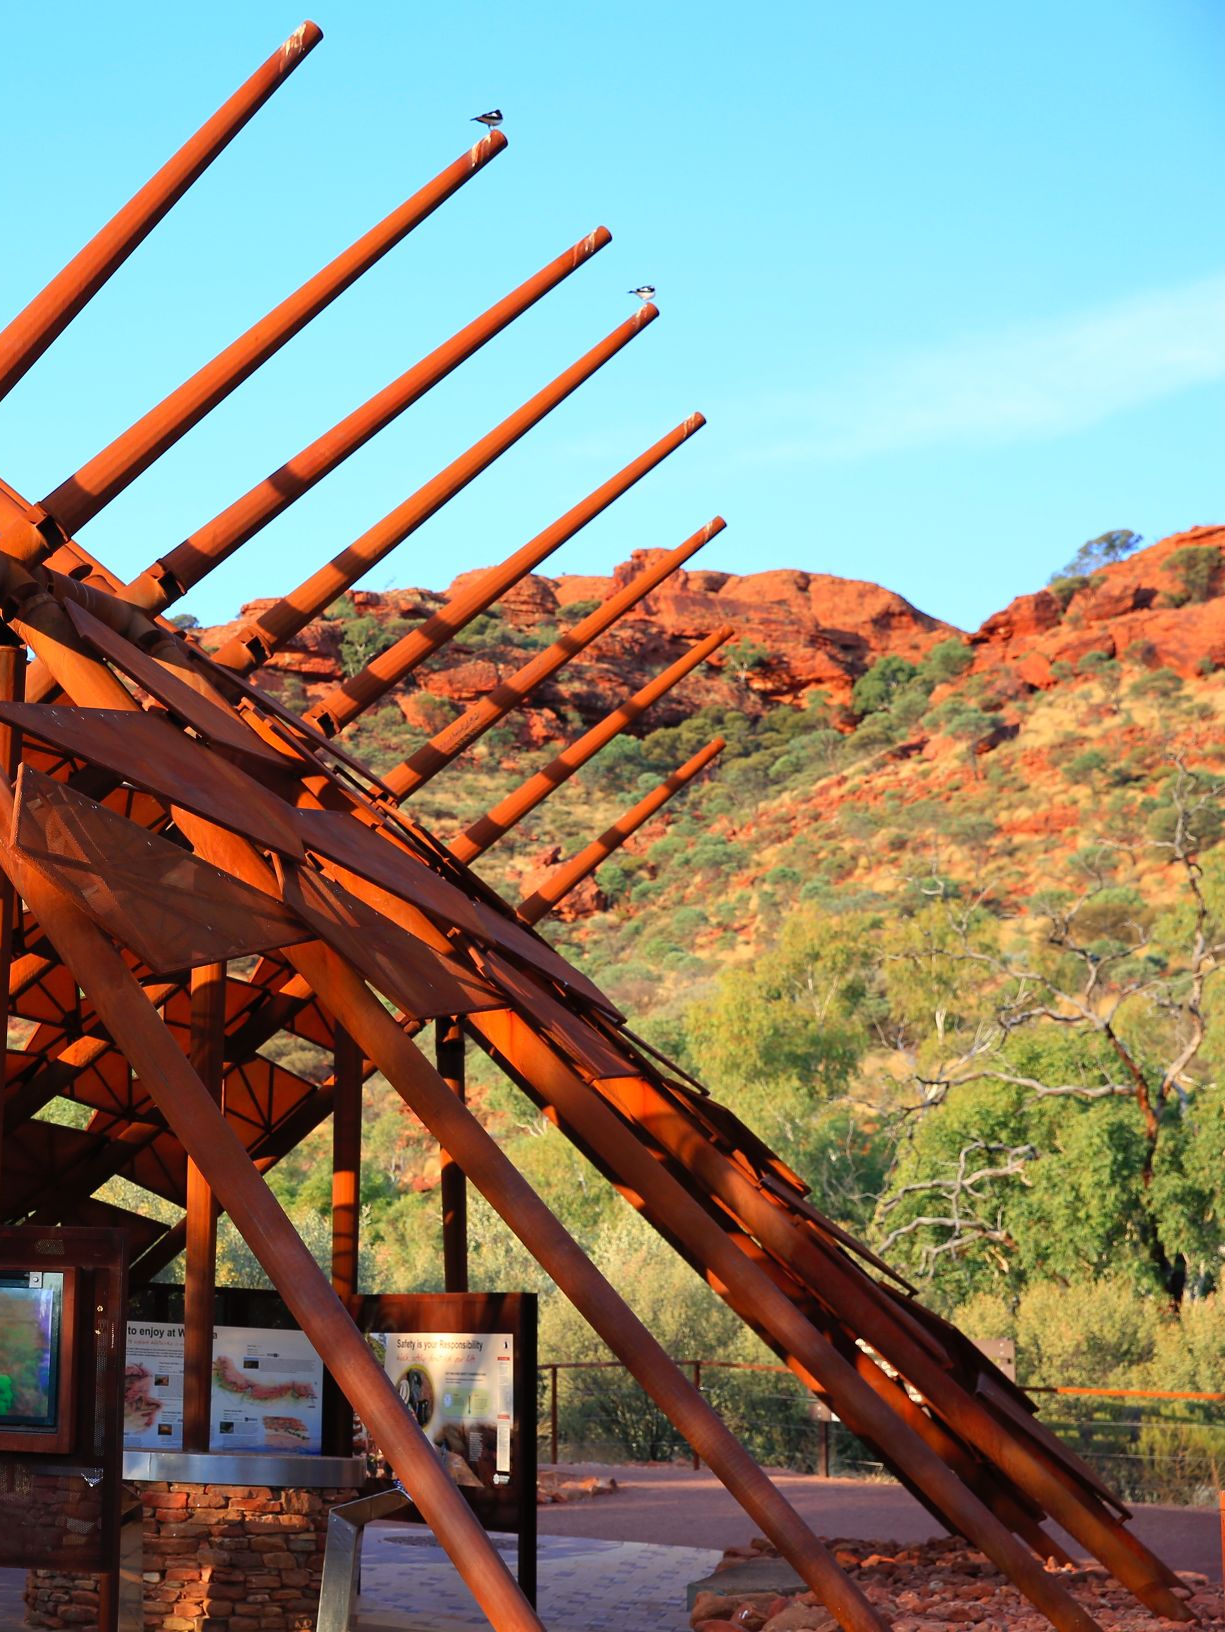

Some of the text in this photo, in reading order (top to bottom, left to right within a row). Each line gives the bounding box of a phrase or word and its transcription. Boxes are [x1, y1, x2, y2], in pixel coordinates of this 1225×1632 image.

[128, 1326, 137, 1335] to
[139, 1327, 164, 1338] enjoy
[167, 1329, 176, 1337] at
[397, 1339, 416, 1350] Safety
[417, 1340, 423, 1349] is
[439, 1340, 483, 1352] Responsibility
